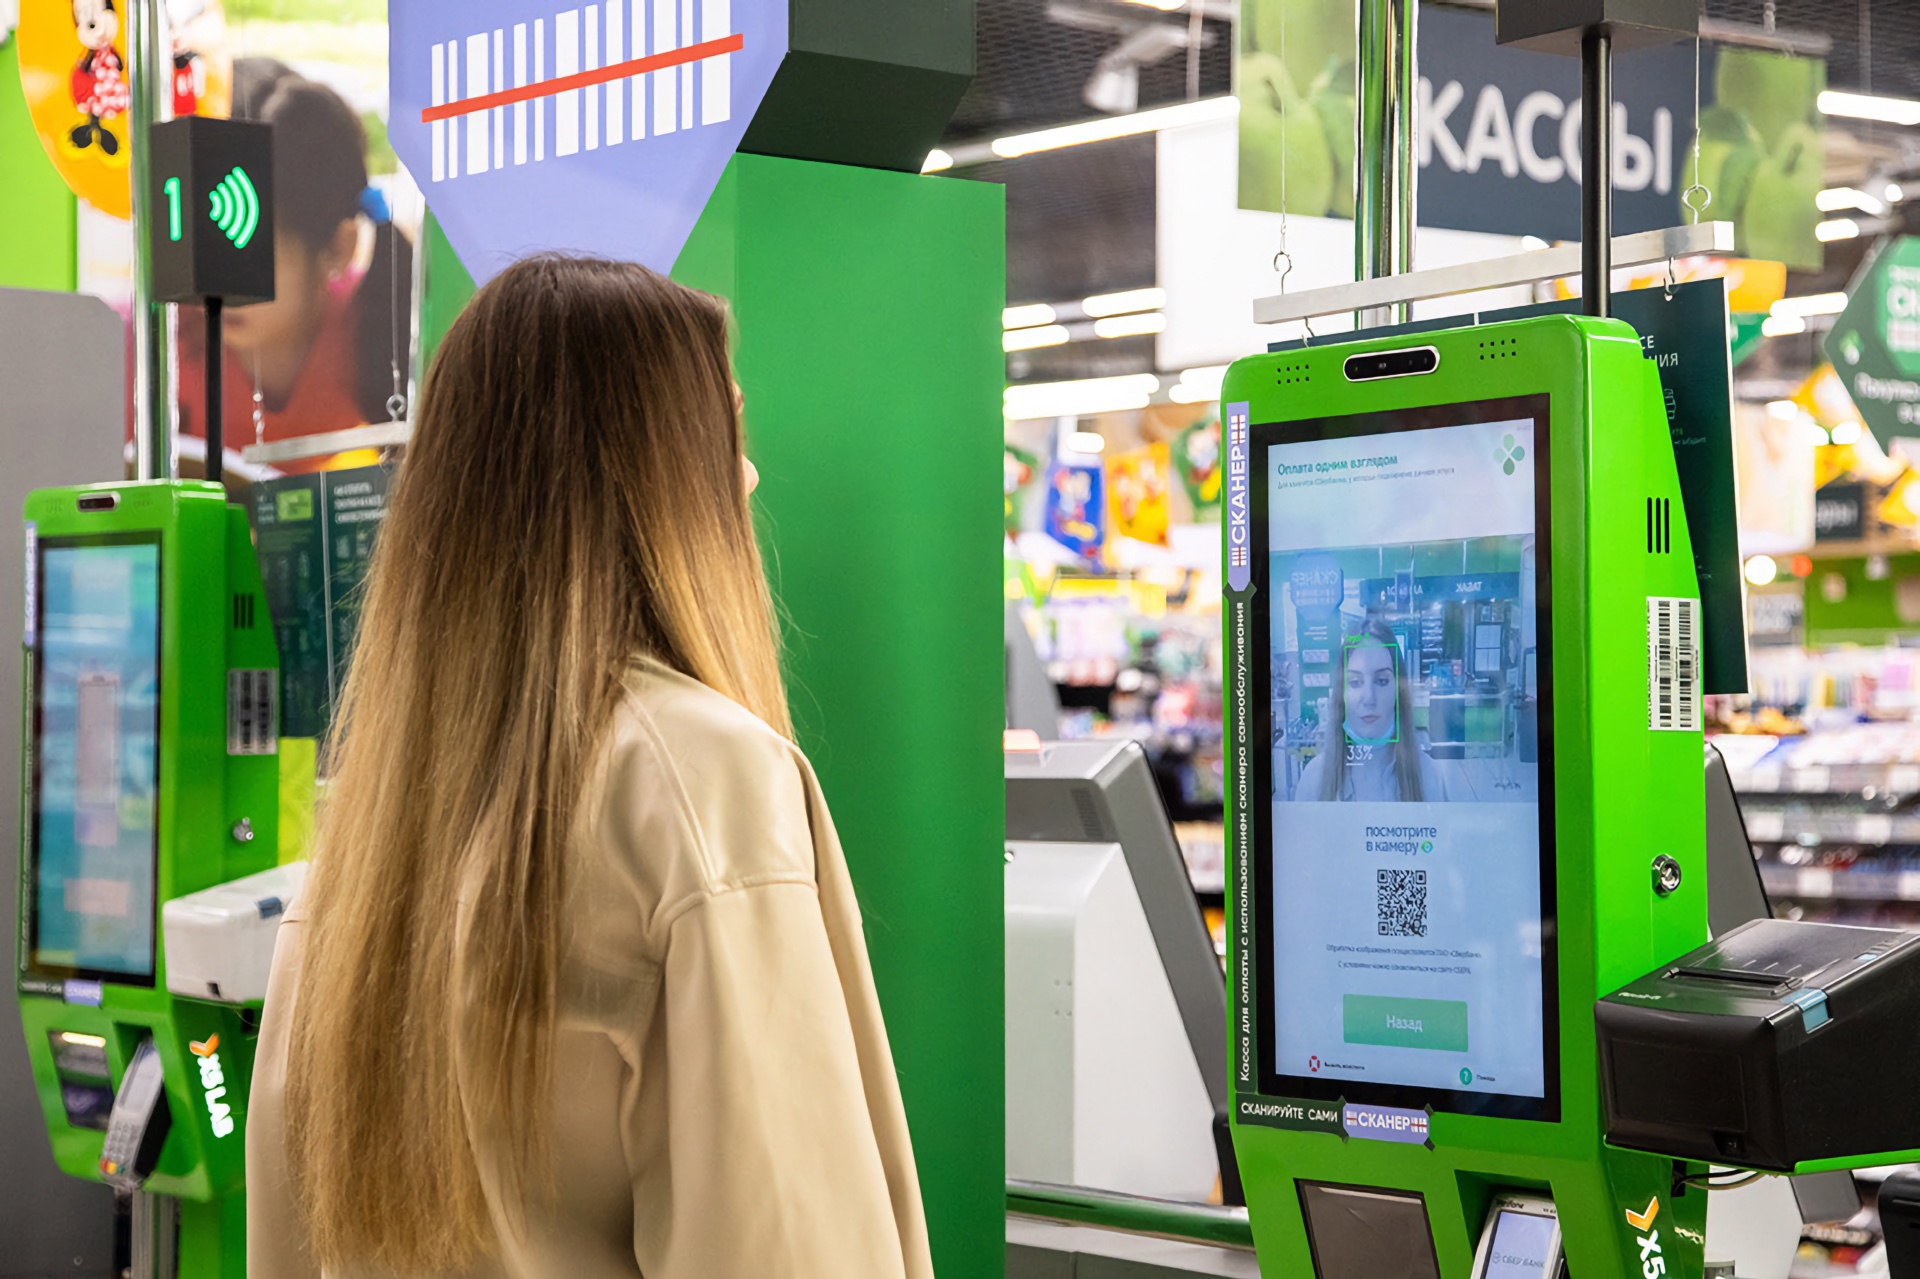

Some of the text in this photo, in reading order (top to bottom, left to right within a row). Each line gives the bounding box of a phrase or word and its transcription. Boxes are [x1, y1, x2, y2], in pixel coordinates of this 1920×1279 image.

[164, 176, 182, 242] 1
[1277, 462, 1314, 476] Оплата
[1315, 459, 1349, 474] одним
[1350, 455, 1398, 470] взглядом
[1231, 446, 1246, 544] СКАНЕР
[1236, 602, 1247, 743] самообслуживания
[1346, 745, 1374, 761] 33%
[1238, 746, 1248, 810] сканера
[1365, 826, 1437, 840] посмотрите
[1366, 841, 1419, 856] в камеру
[1240, 812, 1249, 934] использованием
[1241, 937, 1249, 946] с
[1242, 1007, 1250, 1034] для
[1386, 1014, 1423, 1033] Назад
[1240, 1036, 1250, 1081] Касса
[1241, 1102, 1411, 1131] СКАНИРУЙТЕ САМИ СКАНЕР
